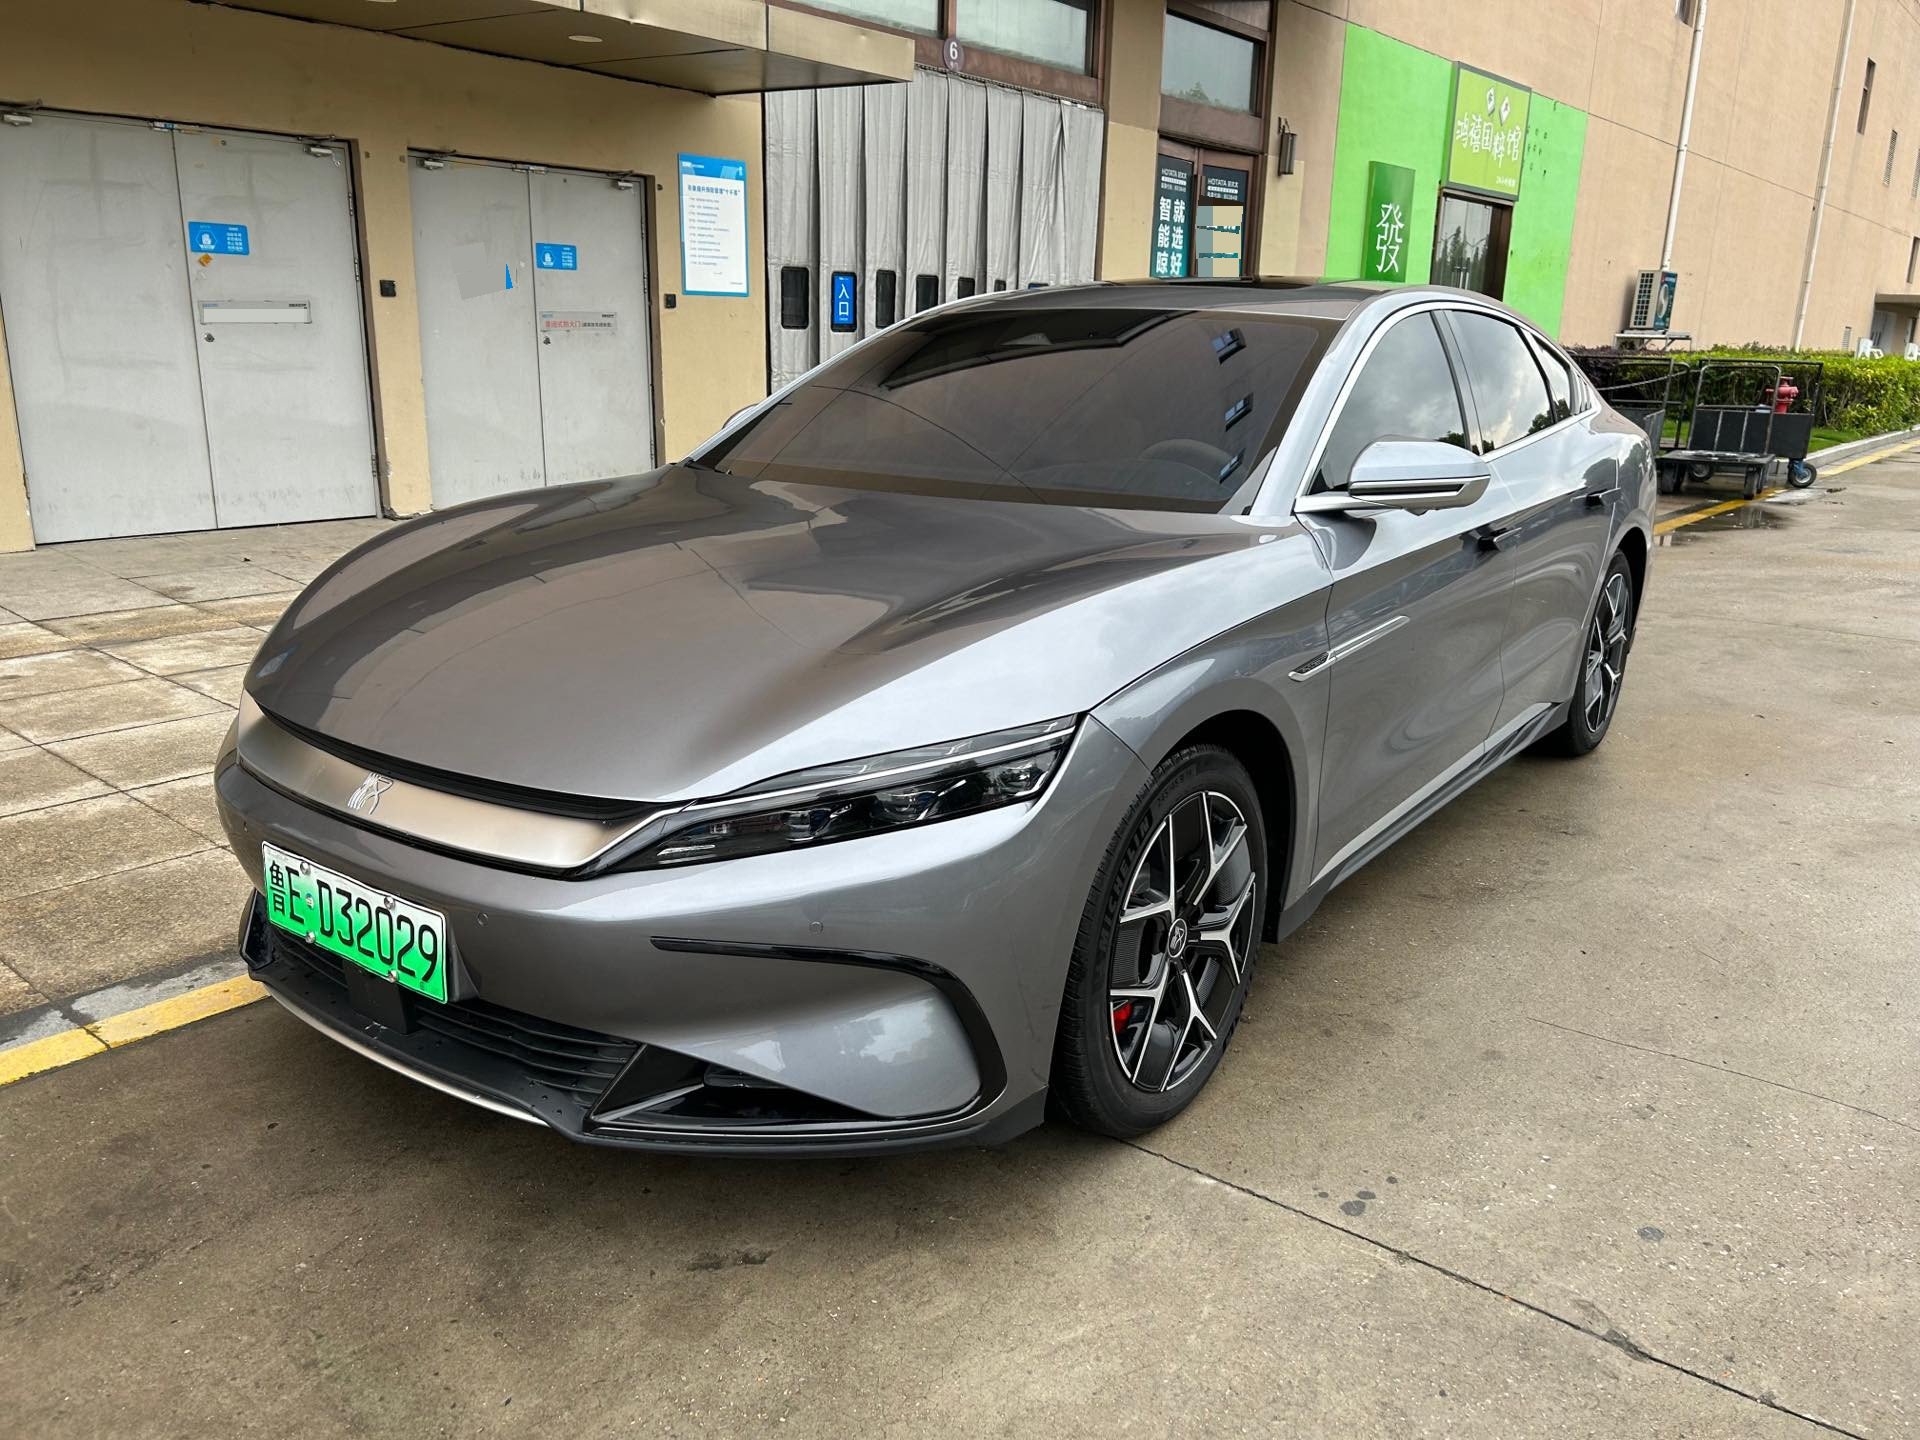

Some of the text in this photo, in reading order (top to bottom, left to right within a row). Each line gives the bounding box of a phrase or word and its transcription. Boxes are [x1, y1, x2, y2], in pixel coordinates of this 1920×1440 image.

[949, 41, 958, 60] 6
[1207, 178, 1227, 186] HOTATA
[838, 284, 850, 316] 入口
[1099, 812, 1154, 953] MICHELIN
